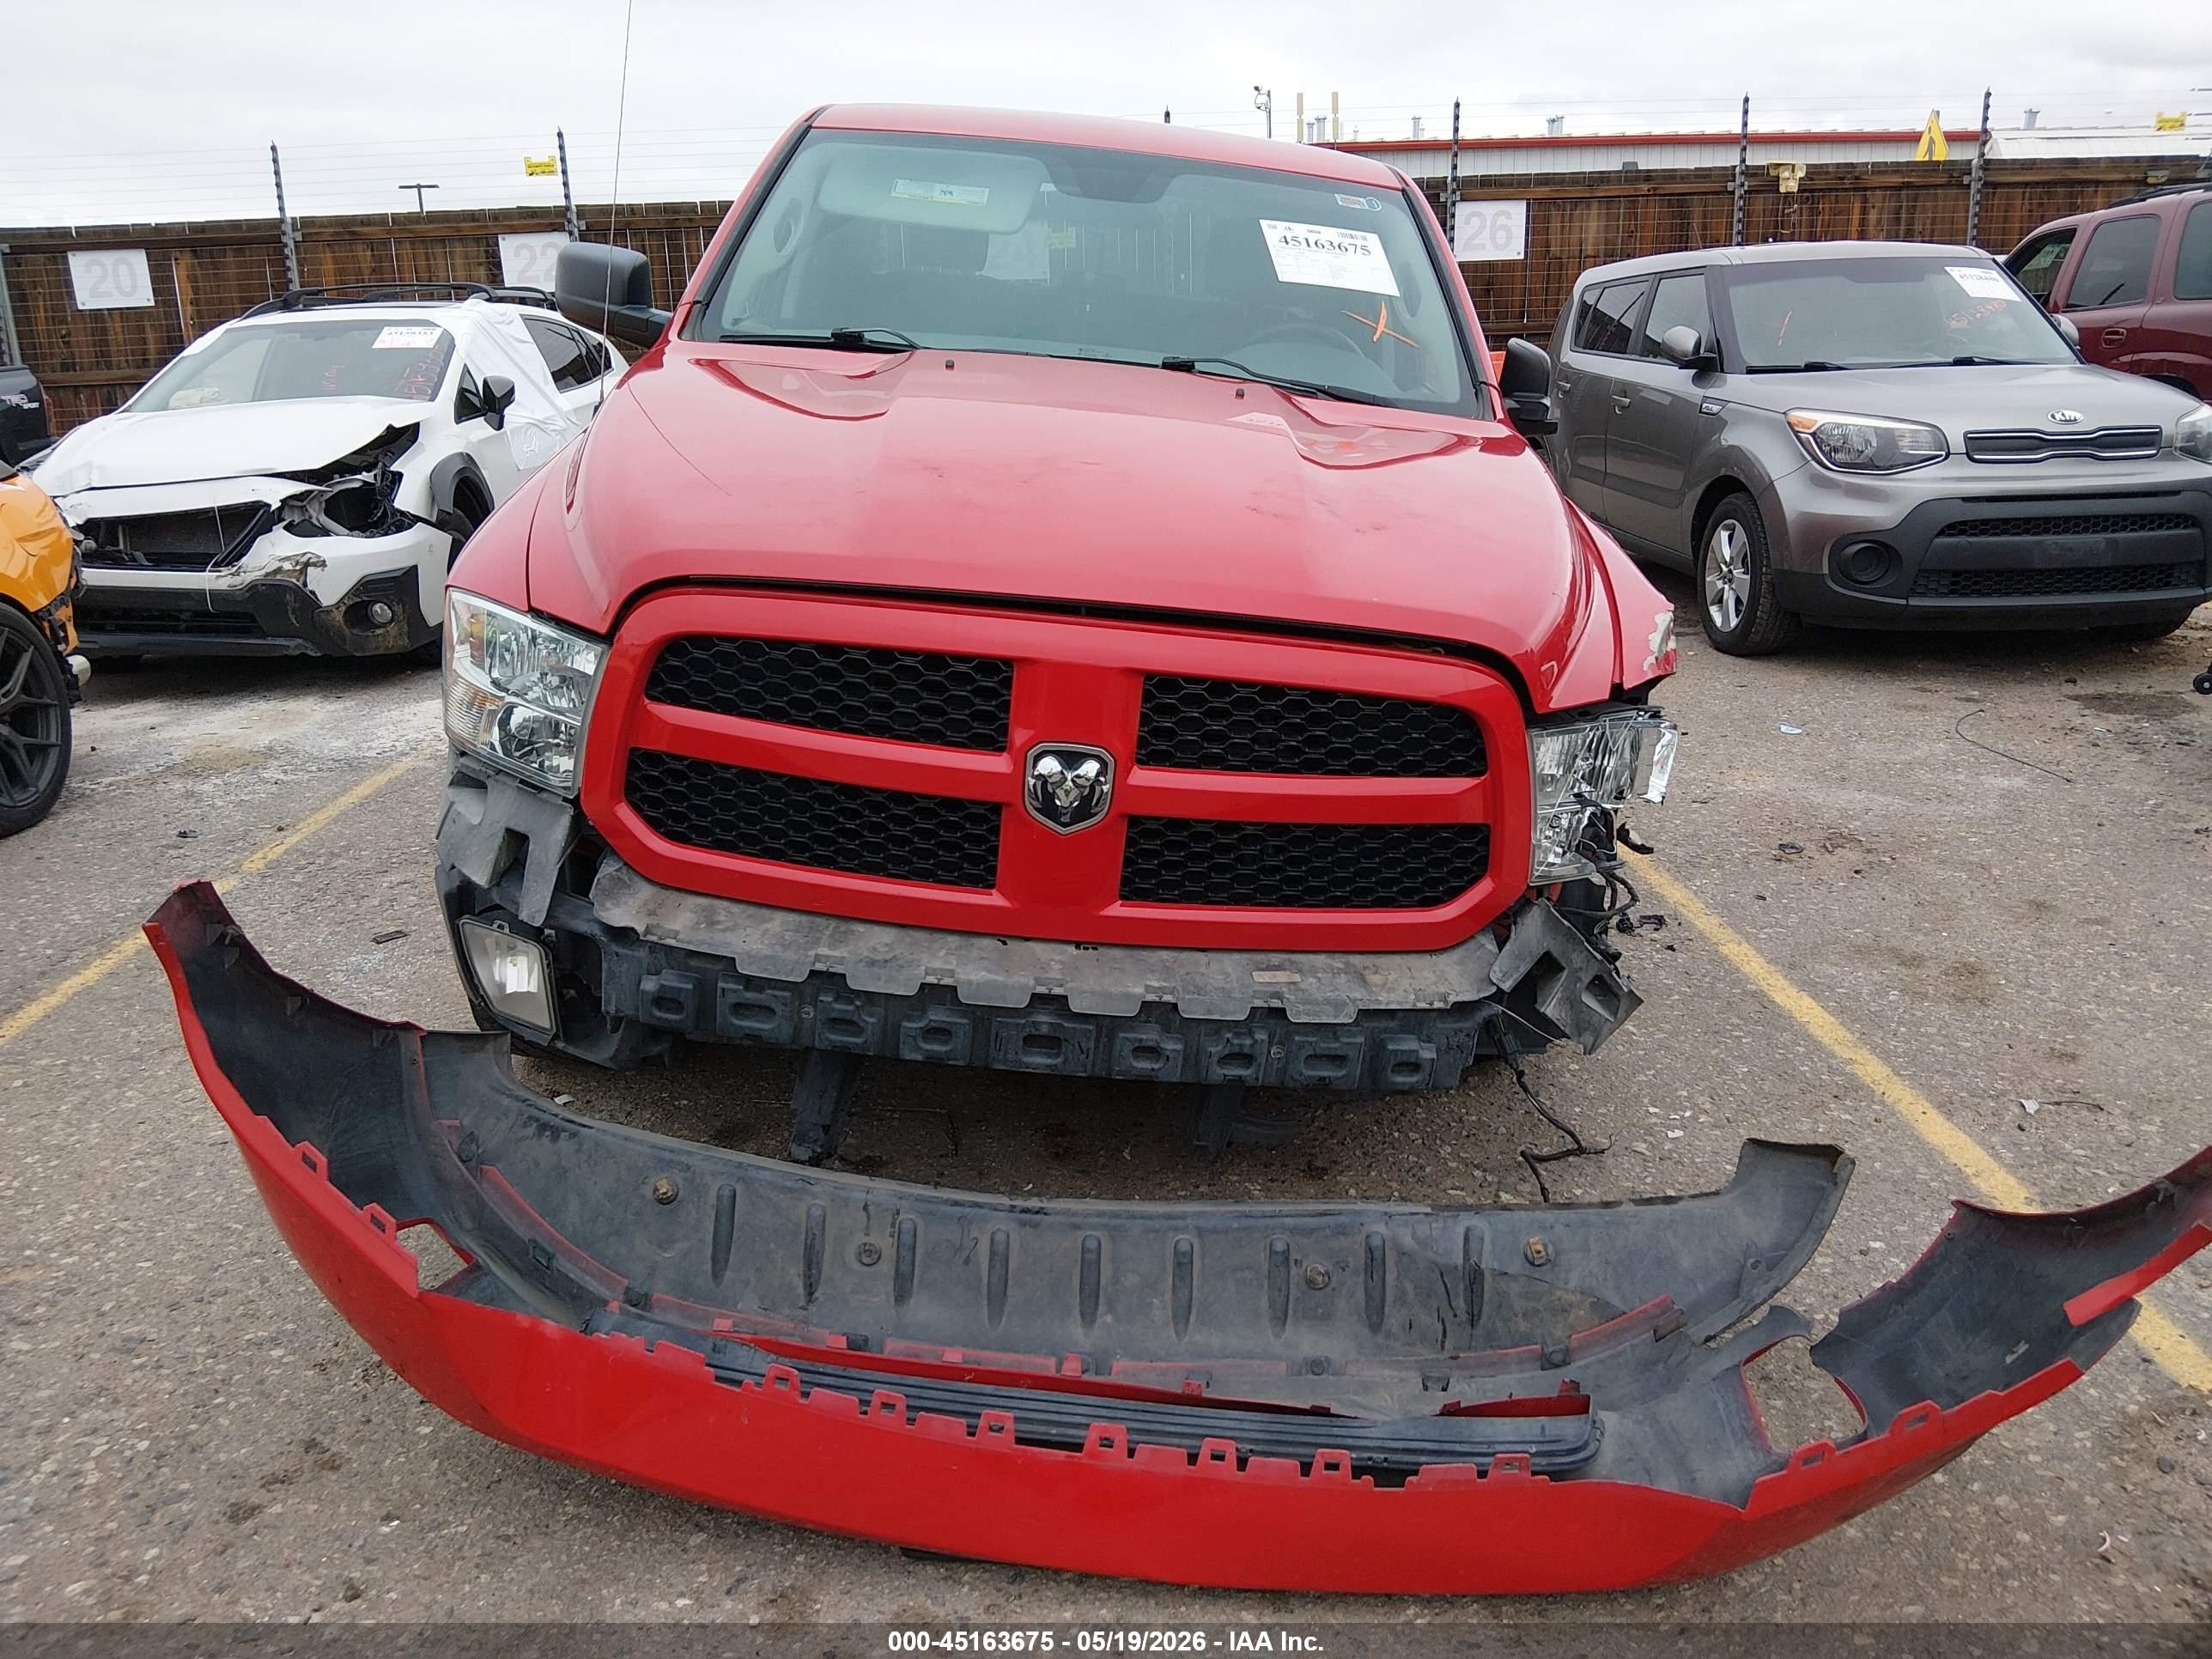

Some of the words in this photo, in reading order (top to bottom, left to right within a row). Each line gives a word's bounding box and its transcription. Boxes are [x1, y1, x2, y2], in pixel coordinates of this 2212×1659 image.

[1279, 234, 1372, 257] 45163675
[1462, 210, 1513, 252] 26
[84, 258, 138, 299] 20
[2049, 410, 2081, 423] KIA
